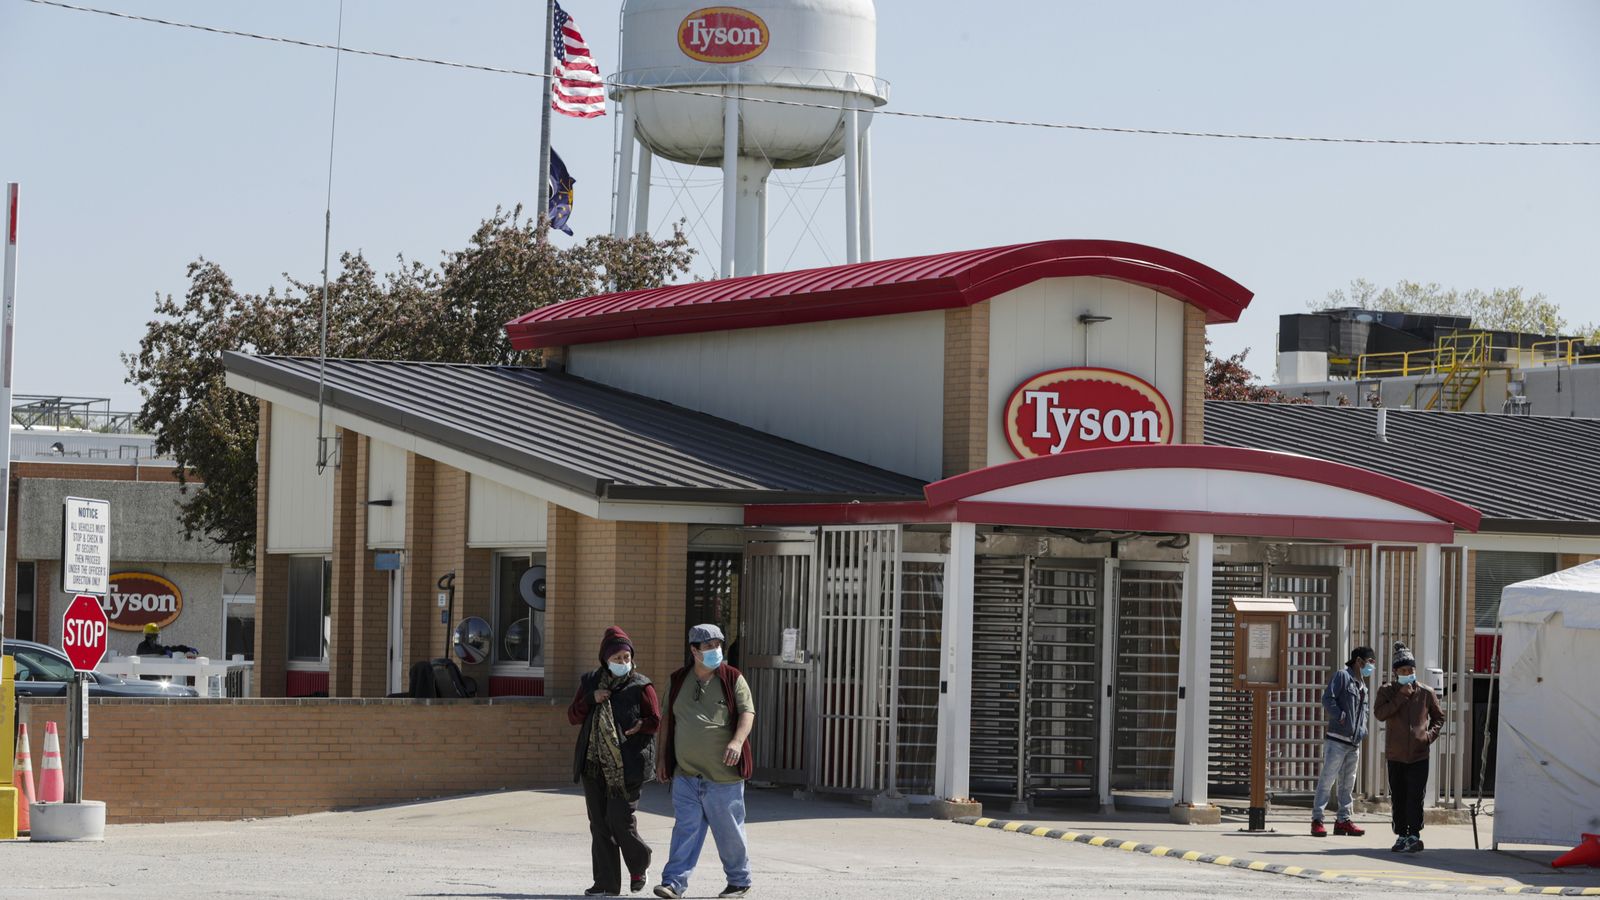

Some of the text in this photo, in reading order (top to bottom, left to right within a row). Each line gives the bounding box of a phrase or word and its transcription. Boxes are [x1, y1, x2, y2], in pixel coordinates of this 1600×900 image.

[687, 18, 762, 52] Tyson
[1025, 390, 1162, 455] Tyson
[78, 507, 98, 519] NOTICE
[78, 522, 95, 532] VEHICLES
[95, 524, 106, 533] MUST
[73, 532, 82, 542] STOP
[87, 534, 98, 543] CHECK
[99, 535, 104, 544] IN
[76, 543, 81, 552] AT
[75, 553, 101, 565] THEN PROCEED
[68, 564, 80, 574] UNDER
[73, 575, 91, 585] DIRECTION
[65, 618, 104, 648] STOP
